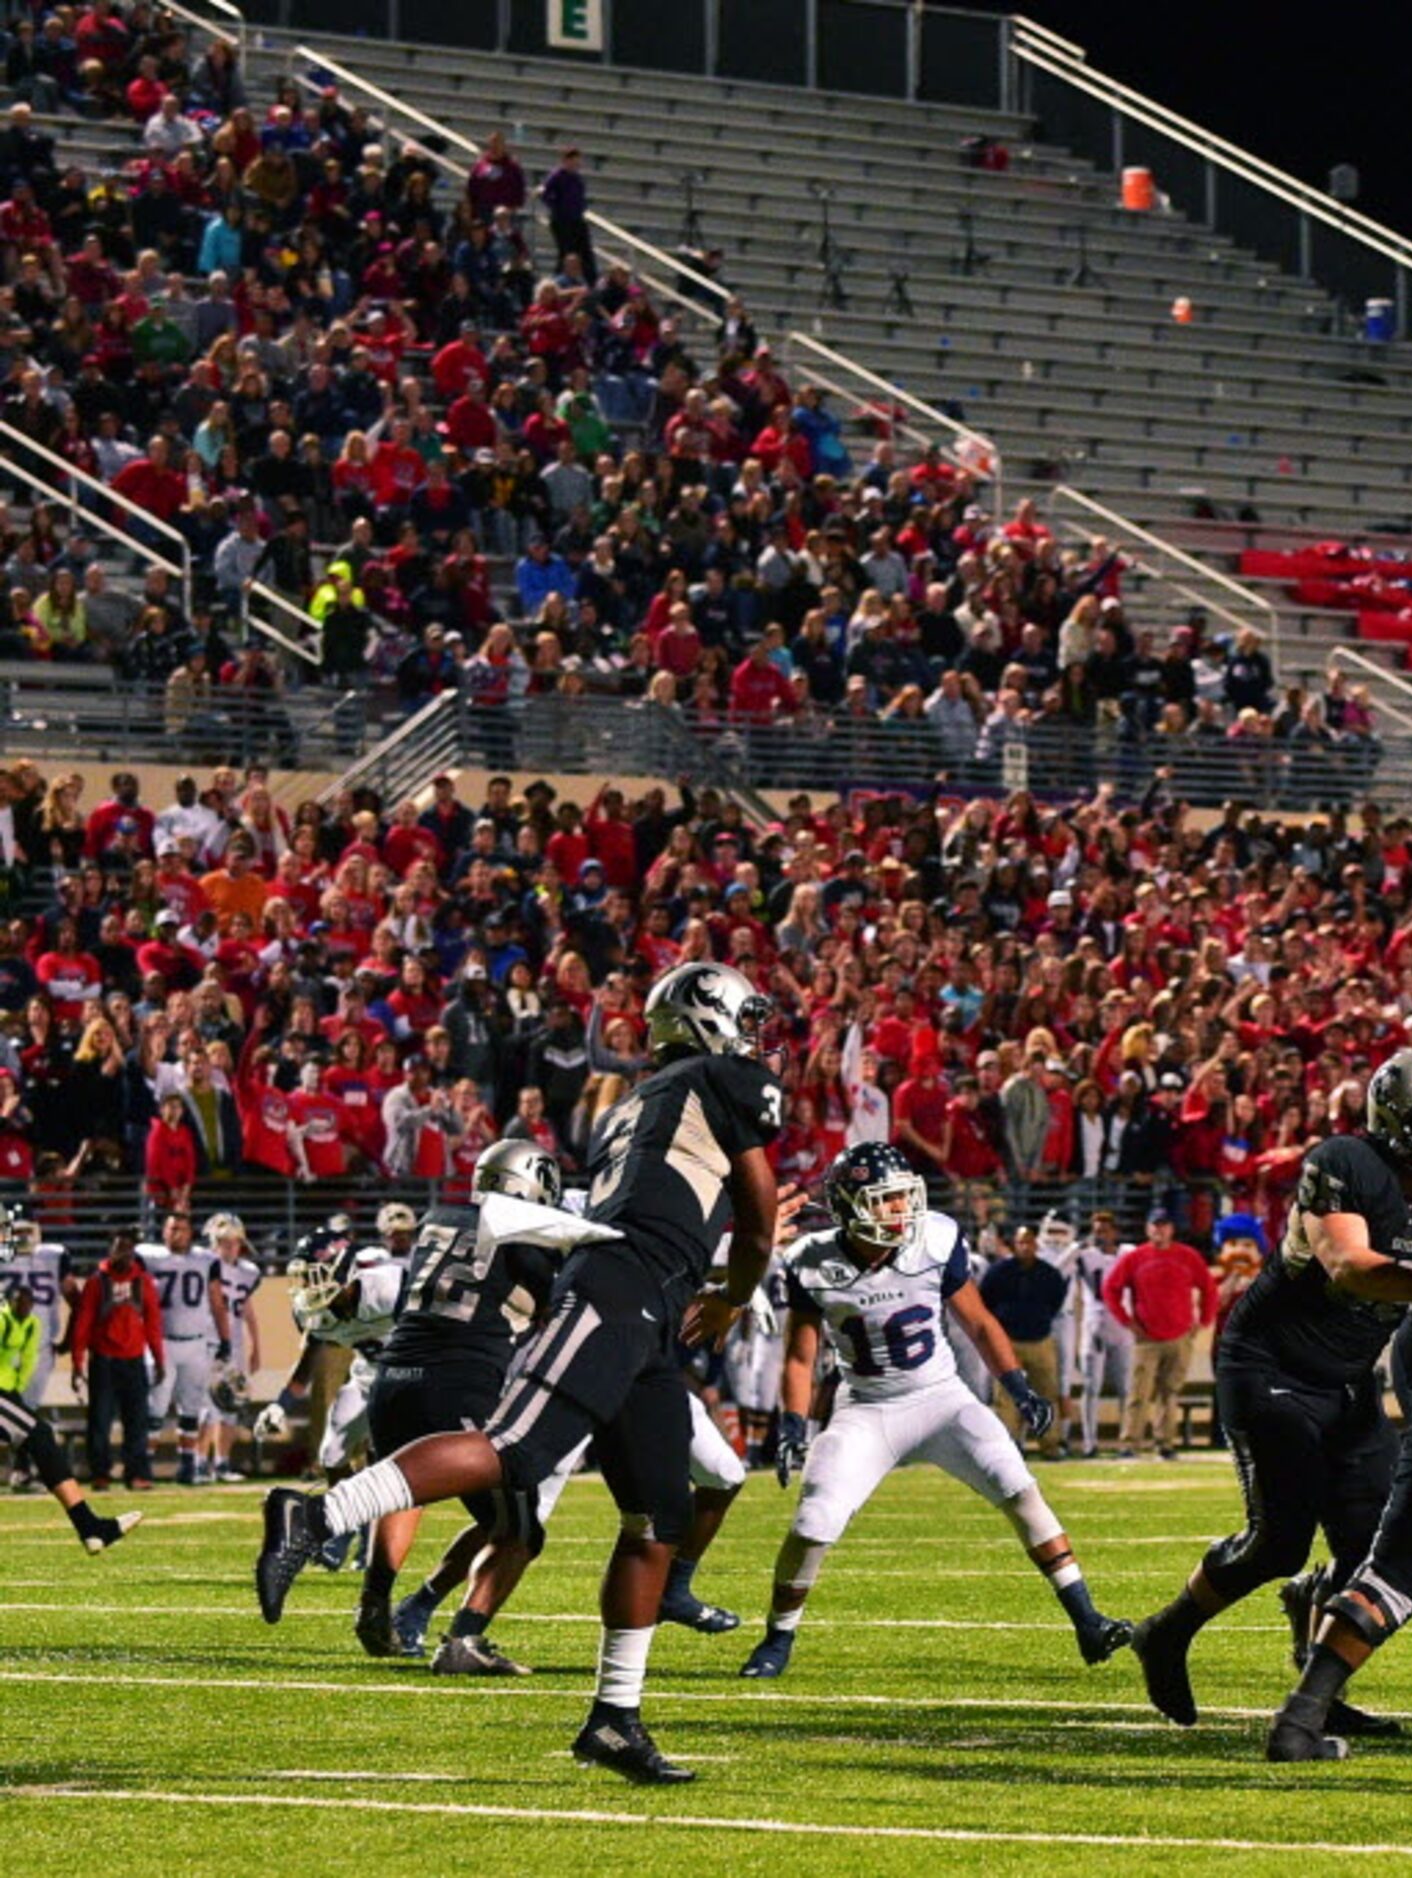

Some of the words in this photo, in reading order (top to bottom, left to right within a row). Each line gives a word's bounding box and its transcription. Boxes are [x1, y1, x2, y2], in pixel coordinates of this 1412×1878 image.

[562, 0, 588, 39] E
[759, 1084, 782, 1126] 3
[0, 1271, 55, 1305] 75
[157, 1270, 204, 1309] 70
[402, 1223, 488, 1323] 72
[841, 1304, 935, 1376] 16
